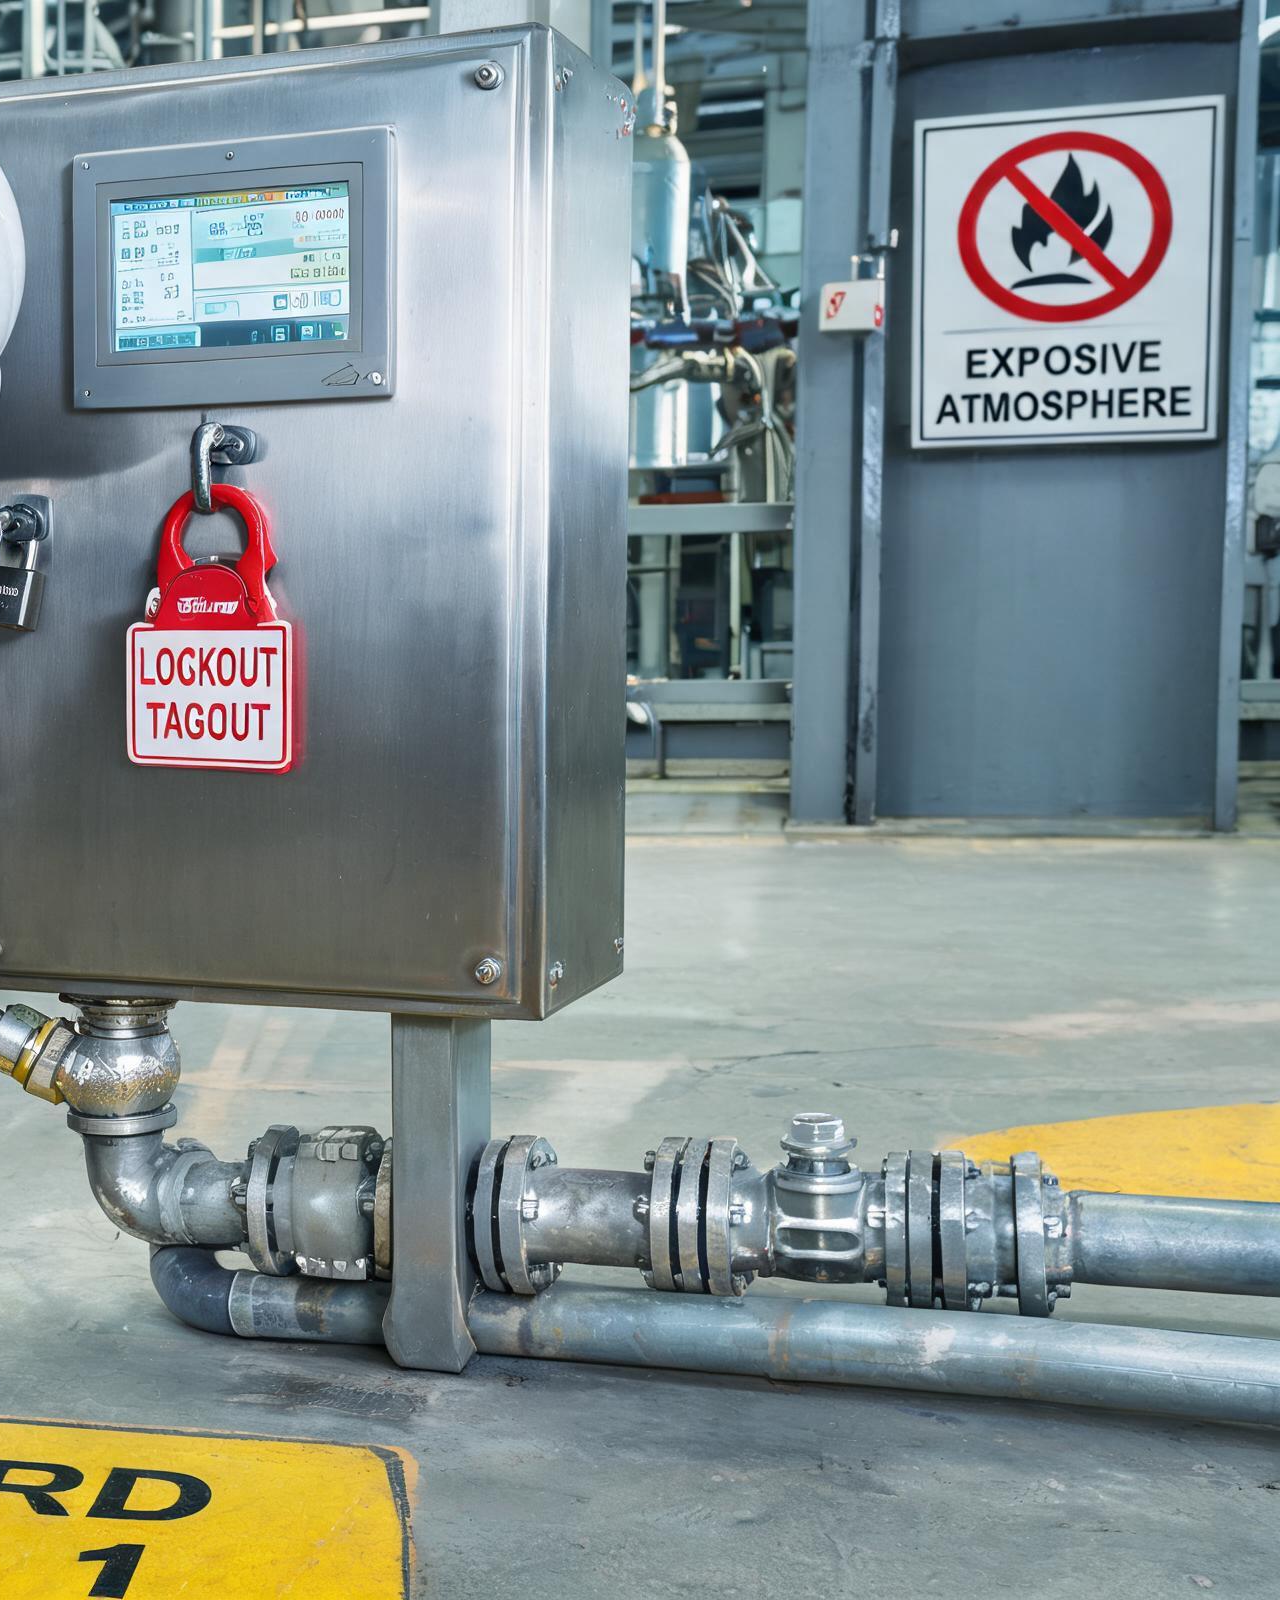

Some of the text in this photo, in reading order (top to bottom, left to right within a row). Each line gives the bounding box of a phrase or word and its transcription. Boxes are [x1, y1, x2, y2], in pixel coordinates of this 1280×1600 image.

[966, 340, 1161, 379] EXPOSIVE
[935, 386, 1192, 425] ATMOSPHERE
[139, 646, 278, 688] LOCKOUT
[145, 701, 272, 742] TAGOUT
[77, 1543, 146, 1600] 1
